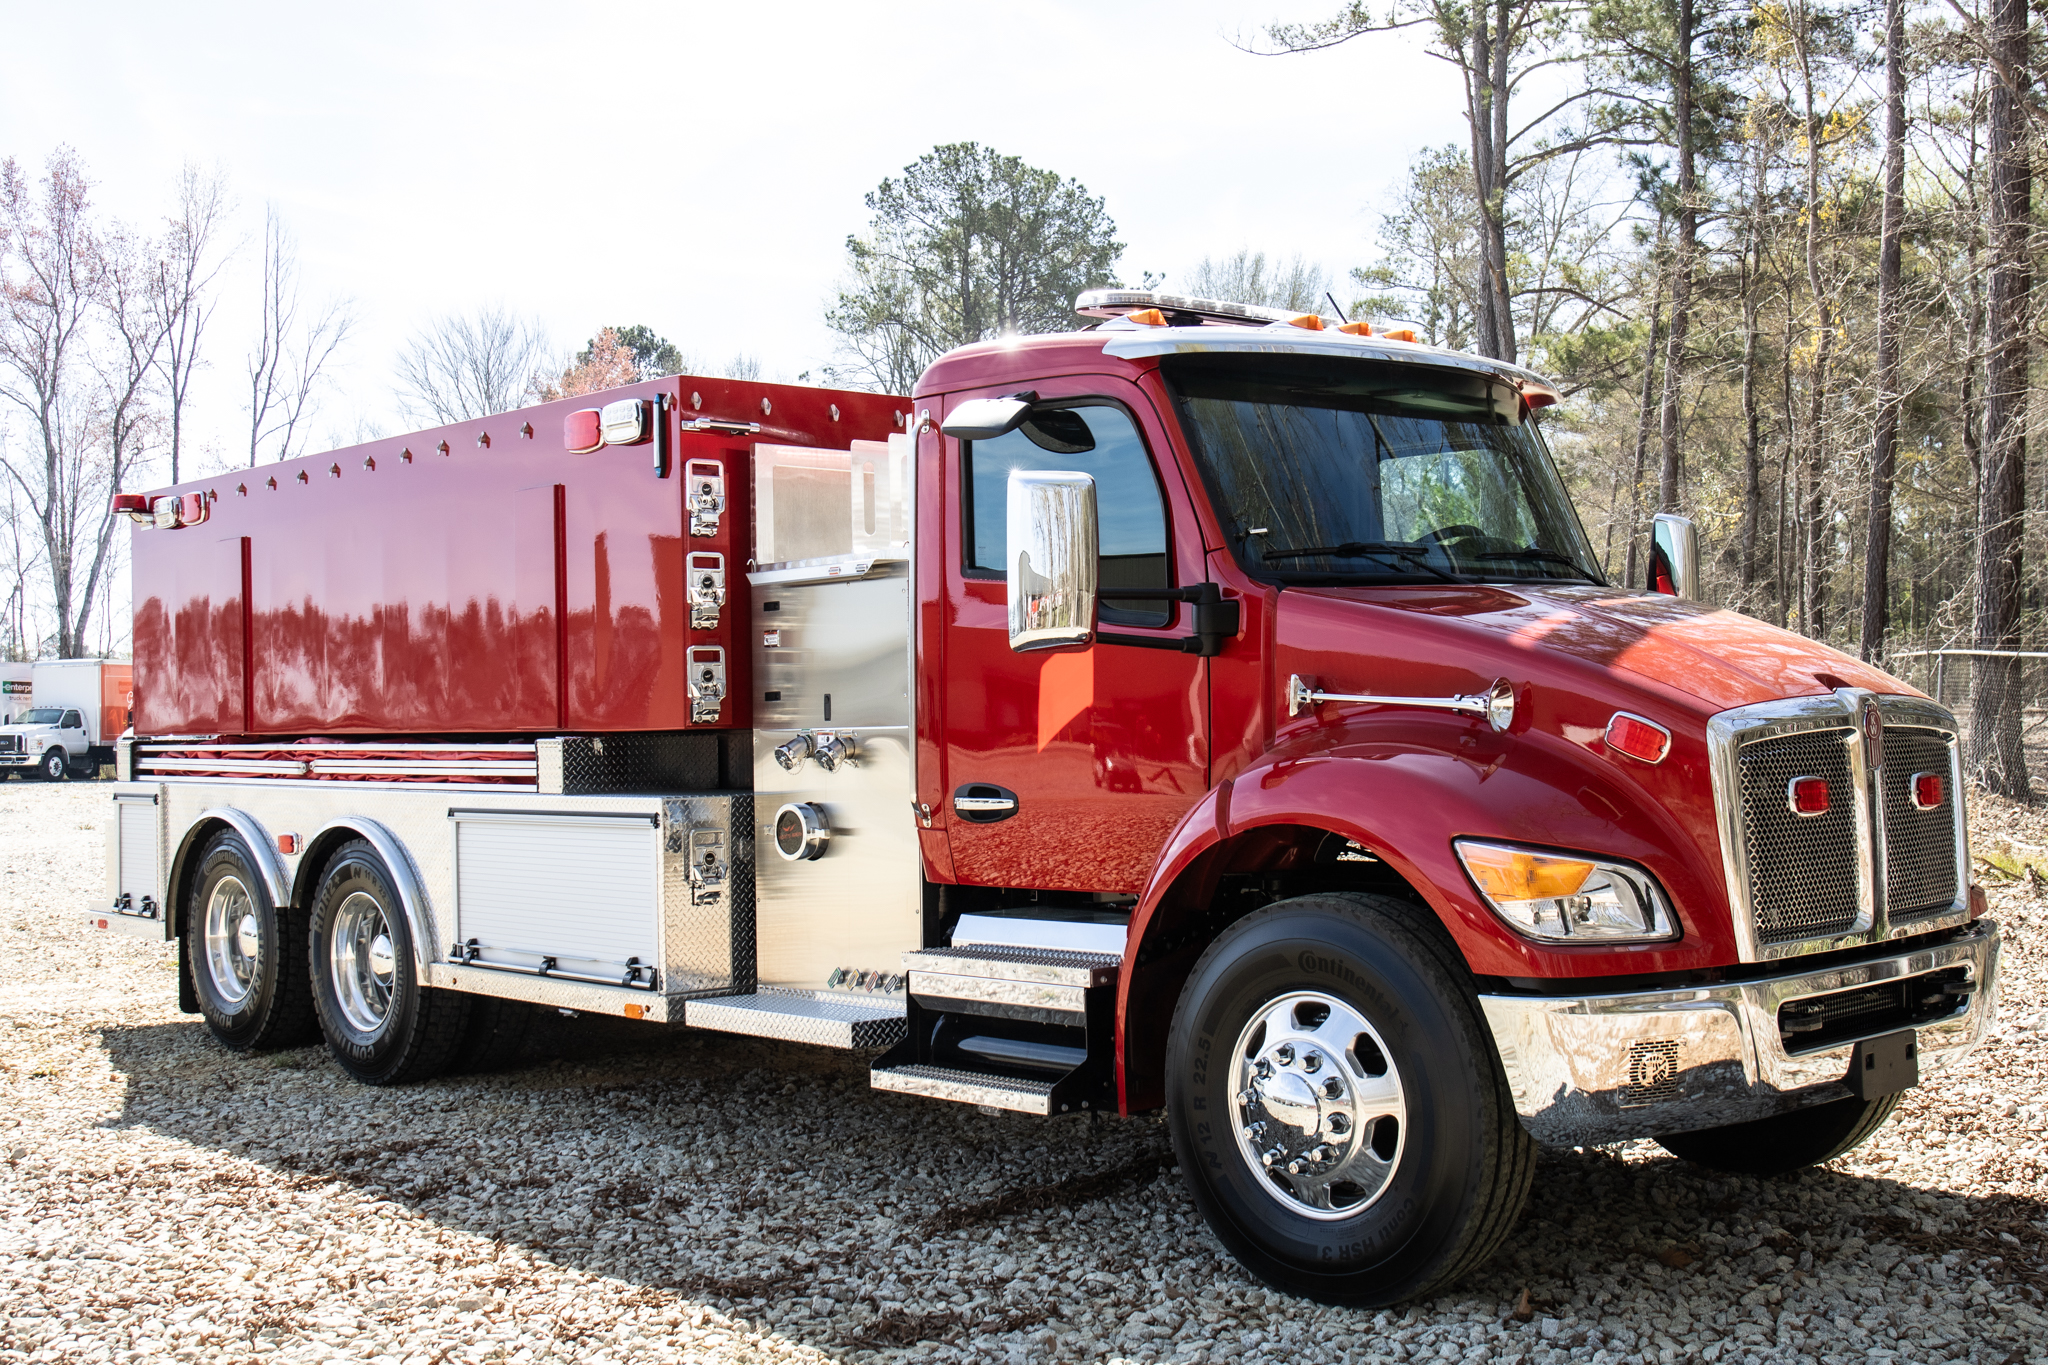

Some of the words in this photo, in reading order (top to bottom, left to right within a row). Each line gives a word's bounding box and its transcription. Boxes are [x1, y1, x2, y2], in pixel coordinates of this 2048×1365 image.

[1298, 949, 1400, 1021] Continental
[1192, 1036, 1211, 1086] 22.5
[1193, 1095, 1207, 1111] R
[1197, 1121, 1213, 1145] 12
[1378, 1197, 1416, 1241] Conti
[1322, 1246, 1332, 1262] 3
[1338, 1236, 1377, 1261] HSR
